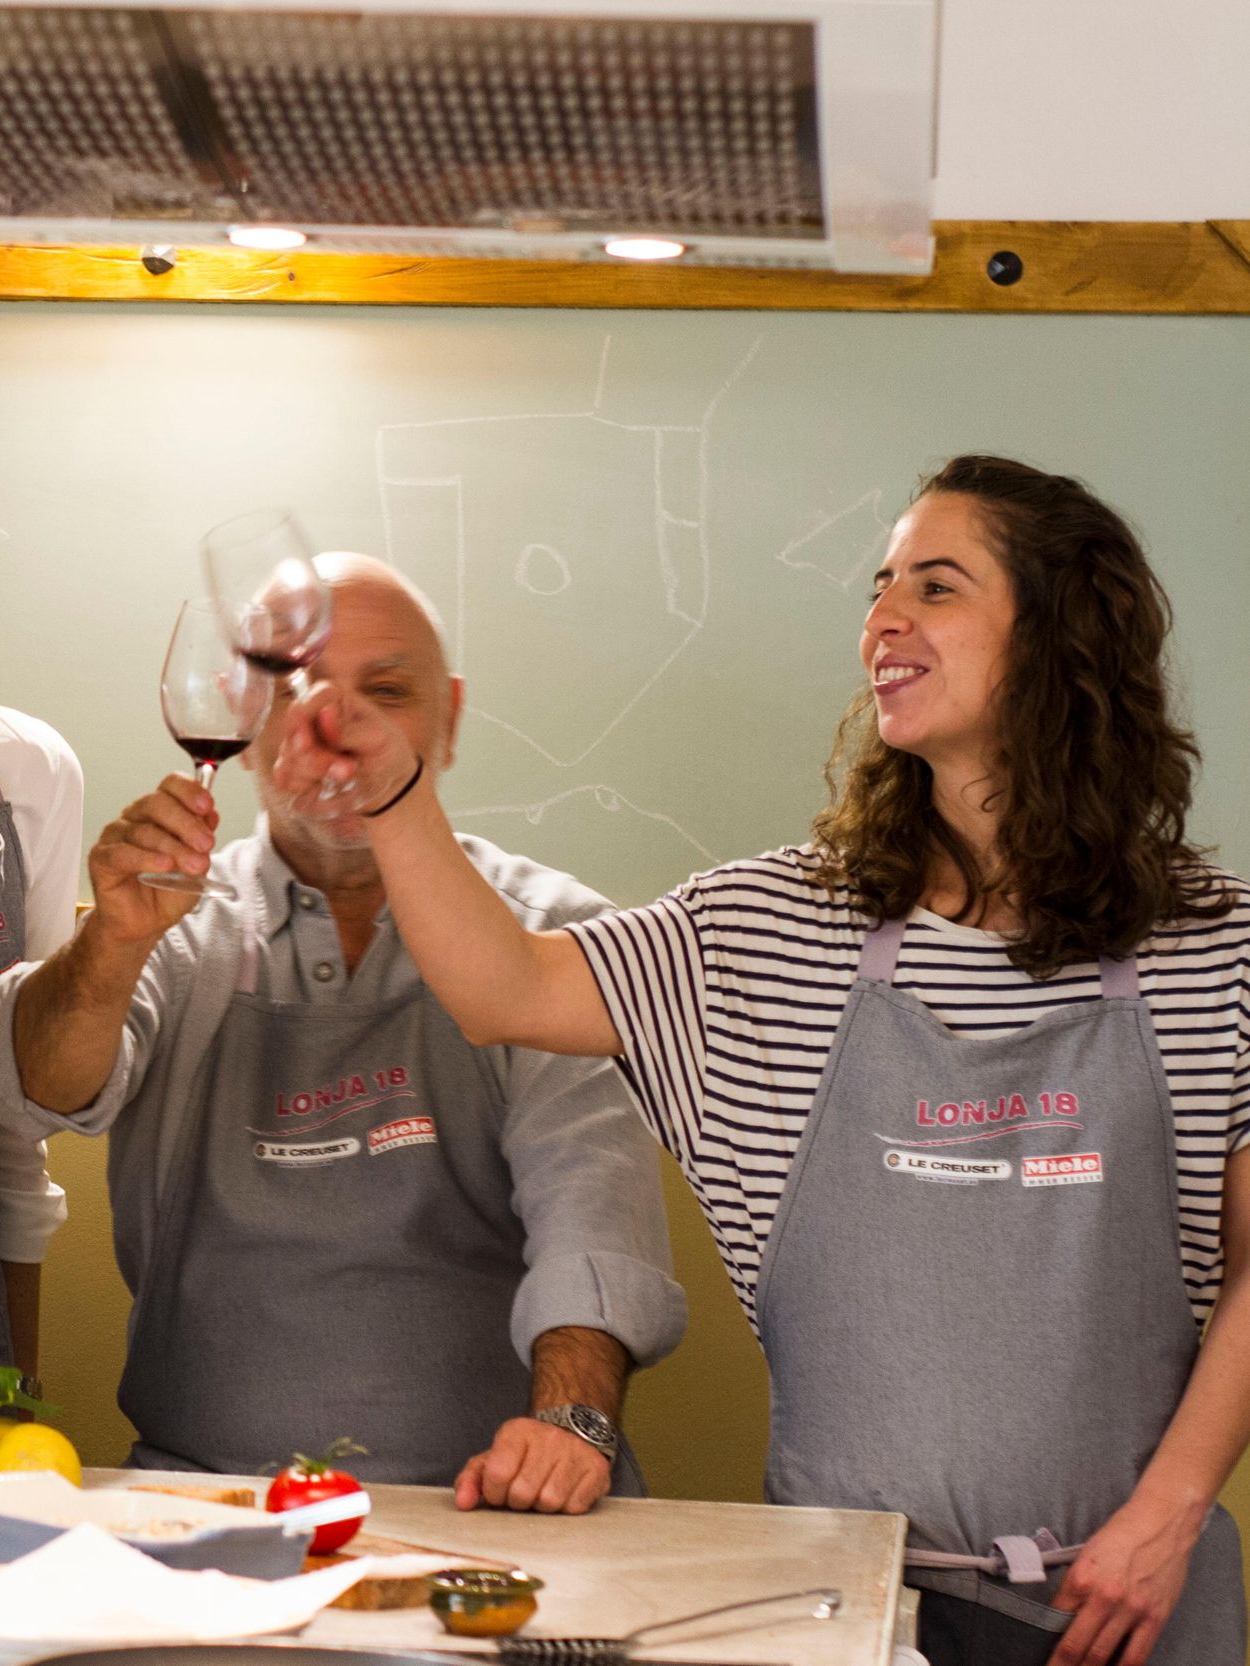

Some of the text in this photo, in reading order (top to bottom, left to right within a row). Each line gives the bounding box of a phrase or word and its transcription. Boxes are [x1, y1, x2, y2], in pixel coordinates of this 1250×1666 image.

[275, 1066, 409, 1117] LONJA 18
[917, 1091, 1080, 1127] LONJA 18
[370, 1121, 431, 1145] Miele
[270, 1148, 287, 1156] LE
[908, 1158, 1000, 1174] LE CREUSET
[1025, 1158, 1098, 1175] Miele
